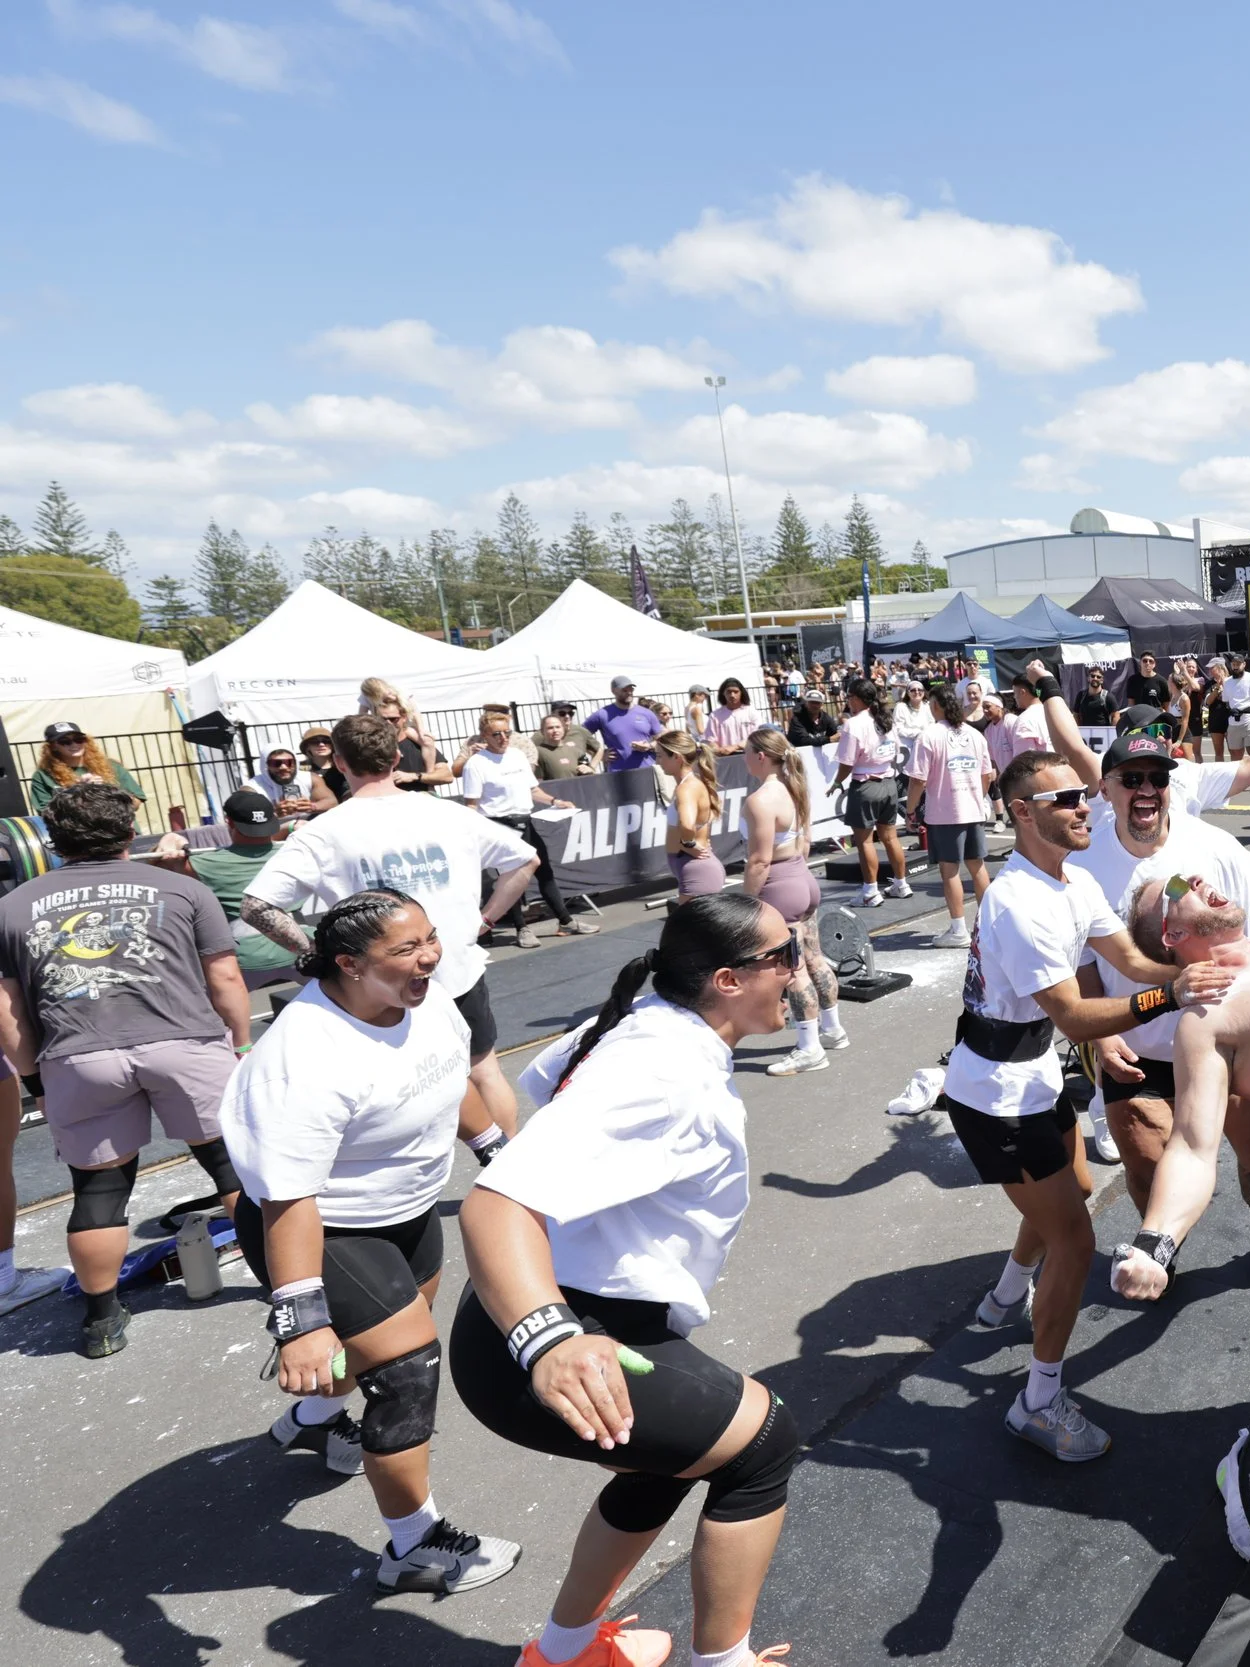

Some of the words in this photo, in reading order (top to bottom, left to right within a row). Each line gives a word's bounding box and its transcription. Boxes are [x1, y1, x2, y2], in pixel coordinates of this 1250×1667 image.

[227, 681, 259, 690] REC
[264, 679, 296, 688] GEN
[560, 786, 748, 864] ALPHIT
[31, 886, 93, 921] NIGHT
[97, 883, 159, 904] SHIFT
[57, 904, 77, 912] TURF
[79, 900, 107, 909] GAMES
[415, 1052, 439, 1079] NO
[275, 1304, 292, 1336] TWL
[425, 1356, 440, 1368] TWL
